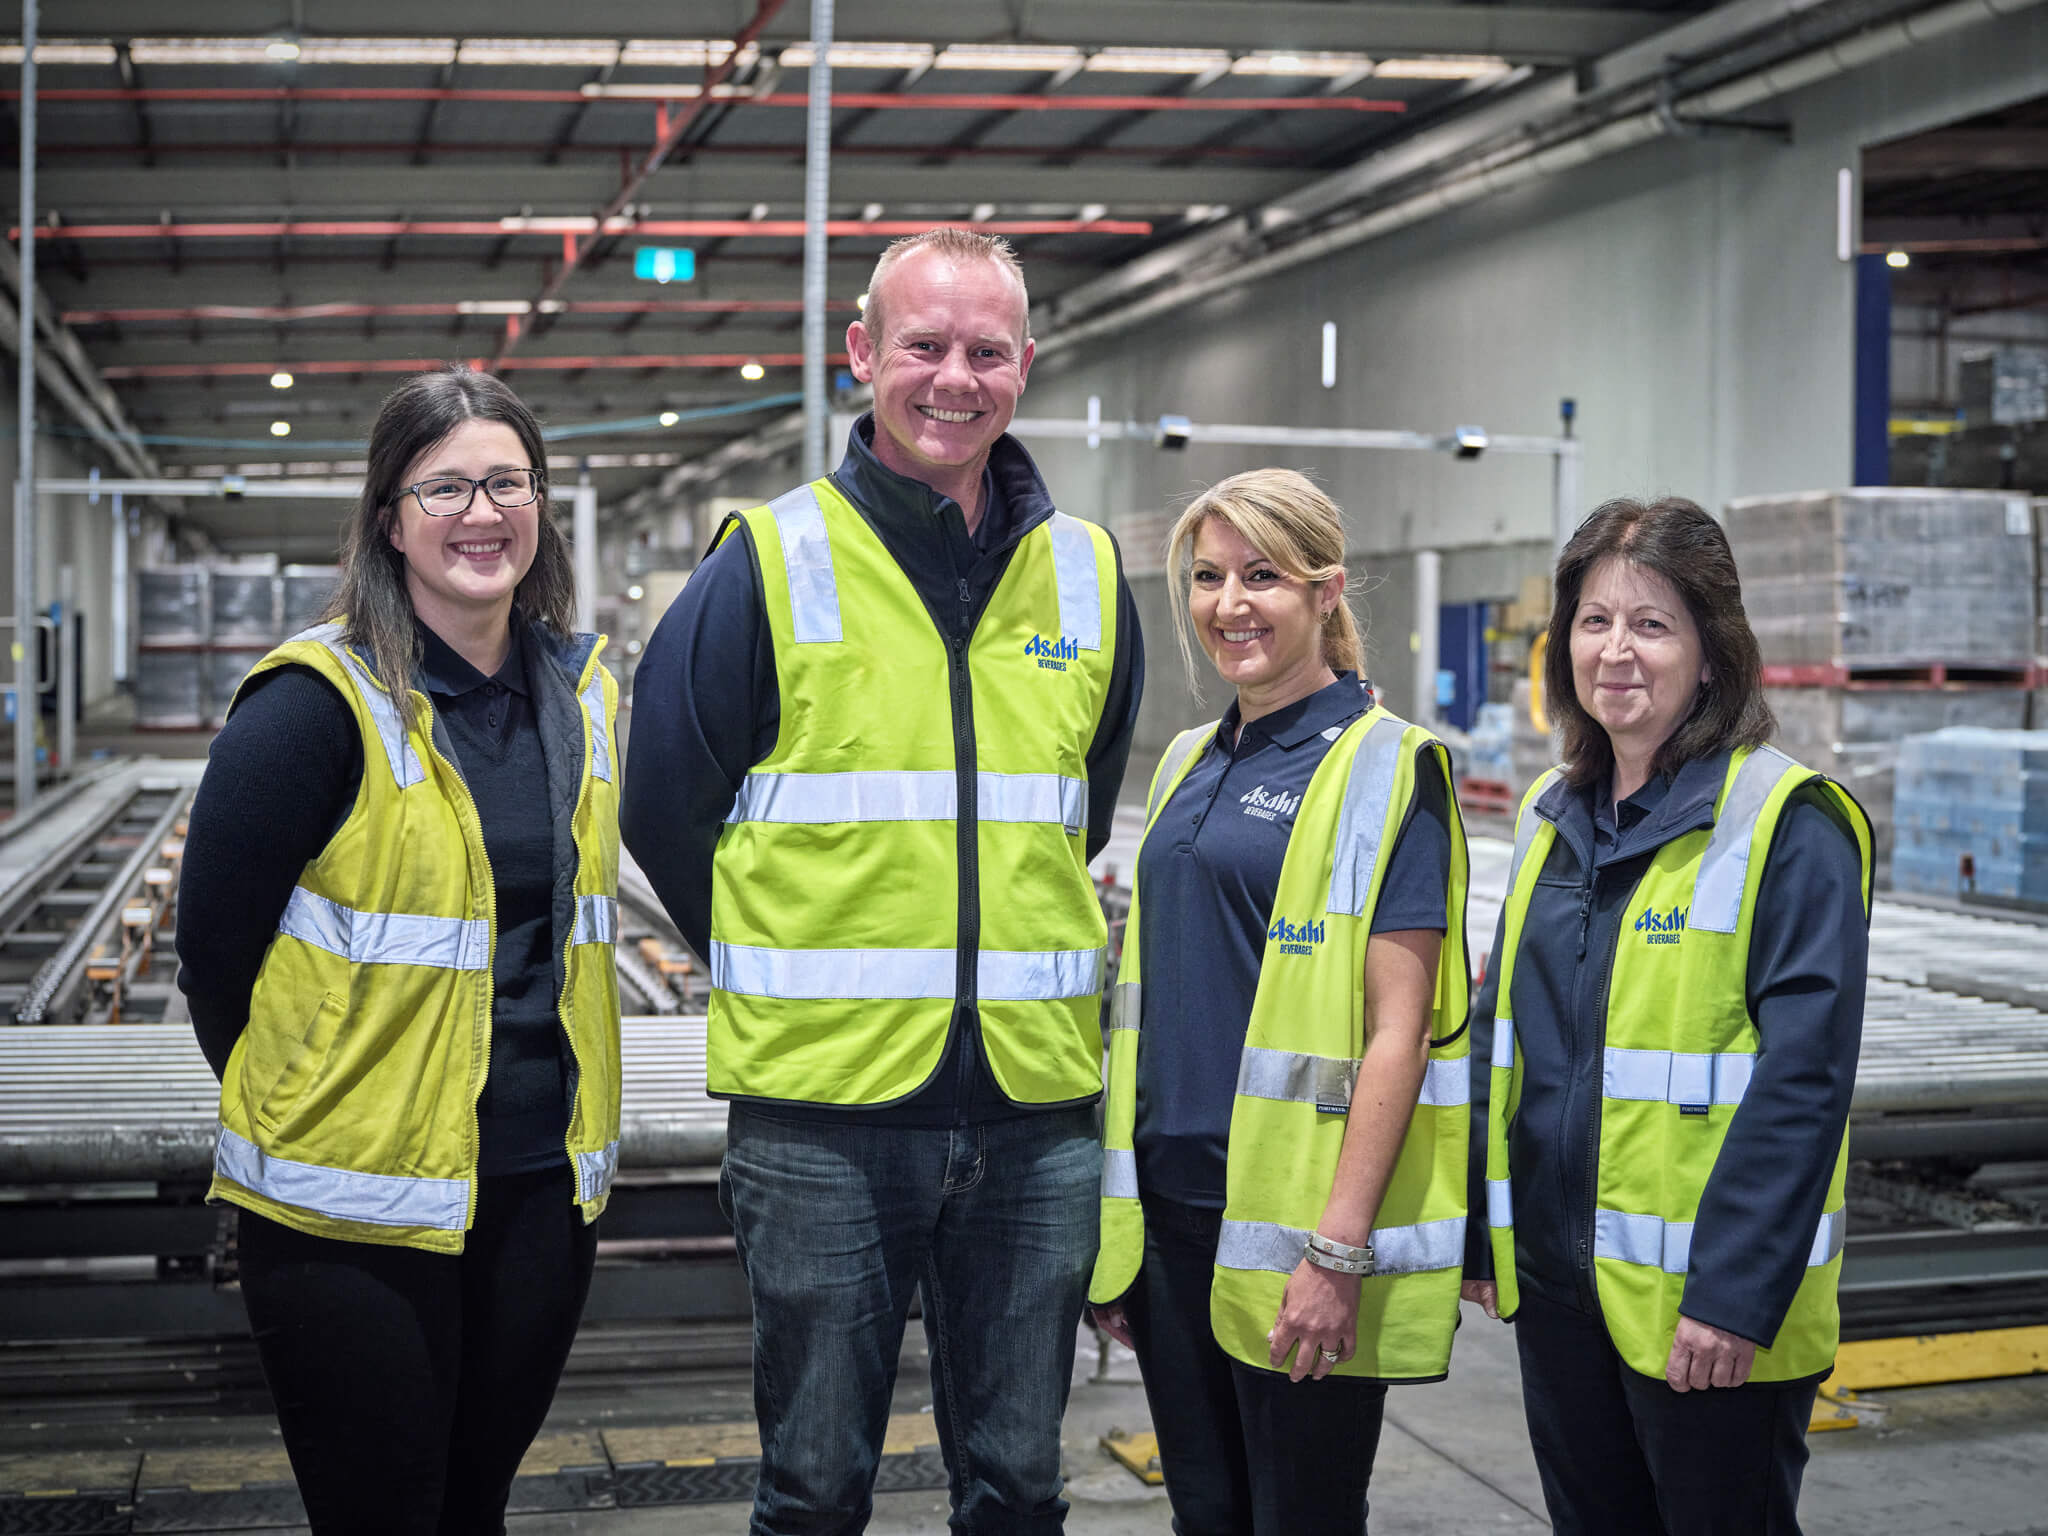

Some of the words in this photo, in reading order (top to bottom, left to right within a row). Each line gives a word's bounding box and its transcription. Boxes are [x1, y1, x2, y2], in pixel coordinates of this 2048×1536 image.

[1024, 633, 1079, 661] Asahi
[1038, 658, 1067, 672] BEVERAGES
[1240, 785, 1301, 815] Asahi
[1268, 916, 1325, 945] Asahi
[1647, 934, 1681, 945] BEVERAGES
[1279, 944, 1313, 956] BEVERAGES
